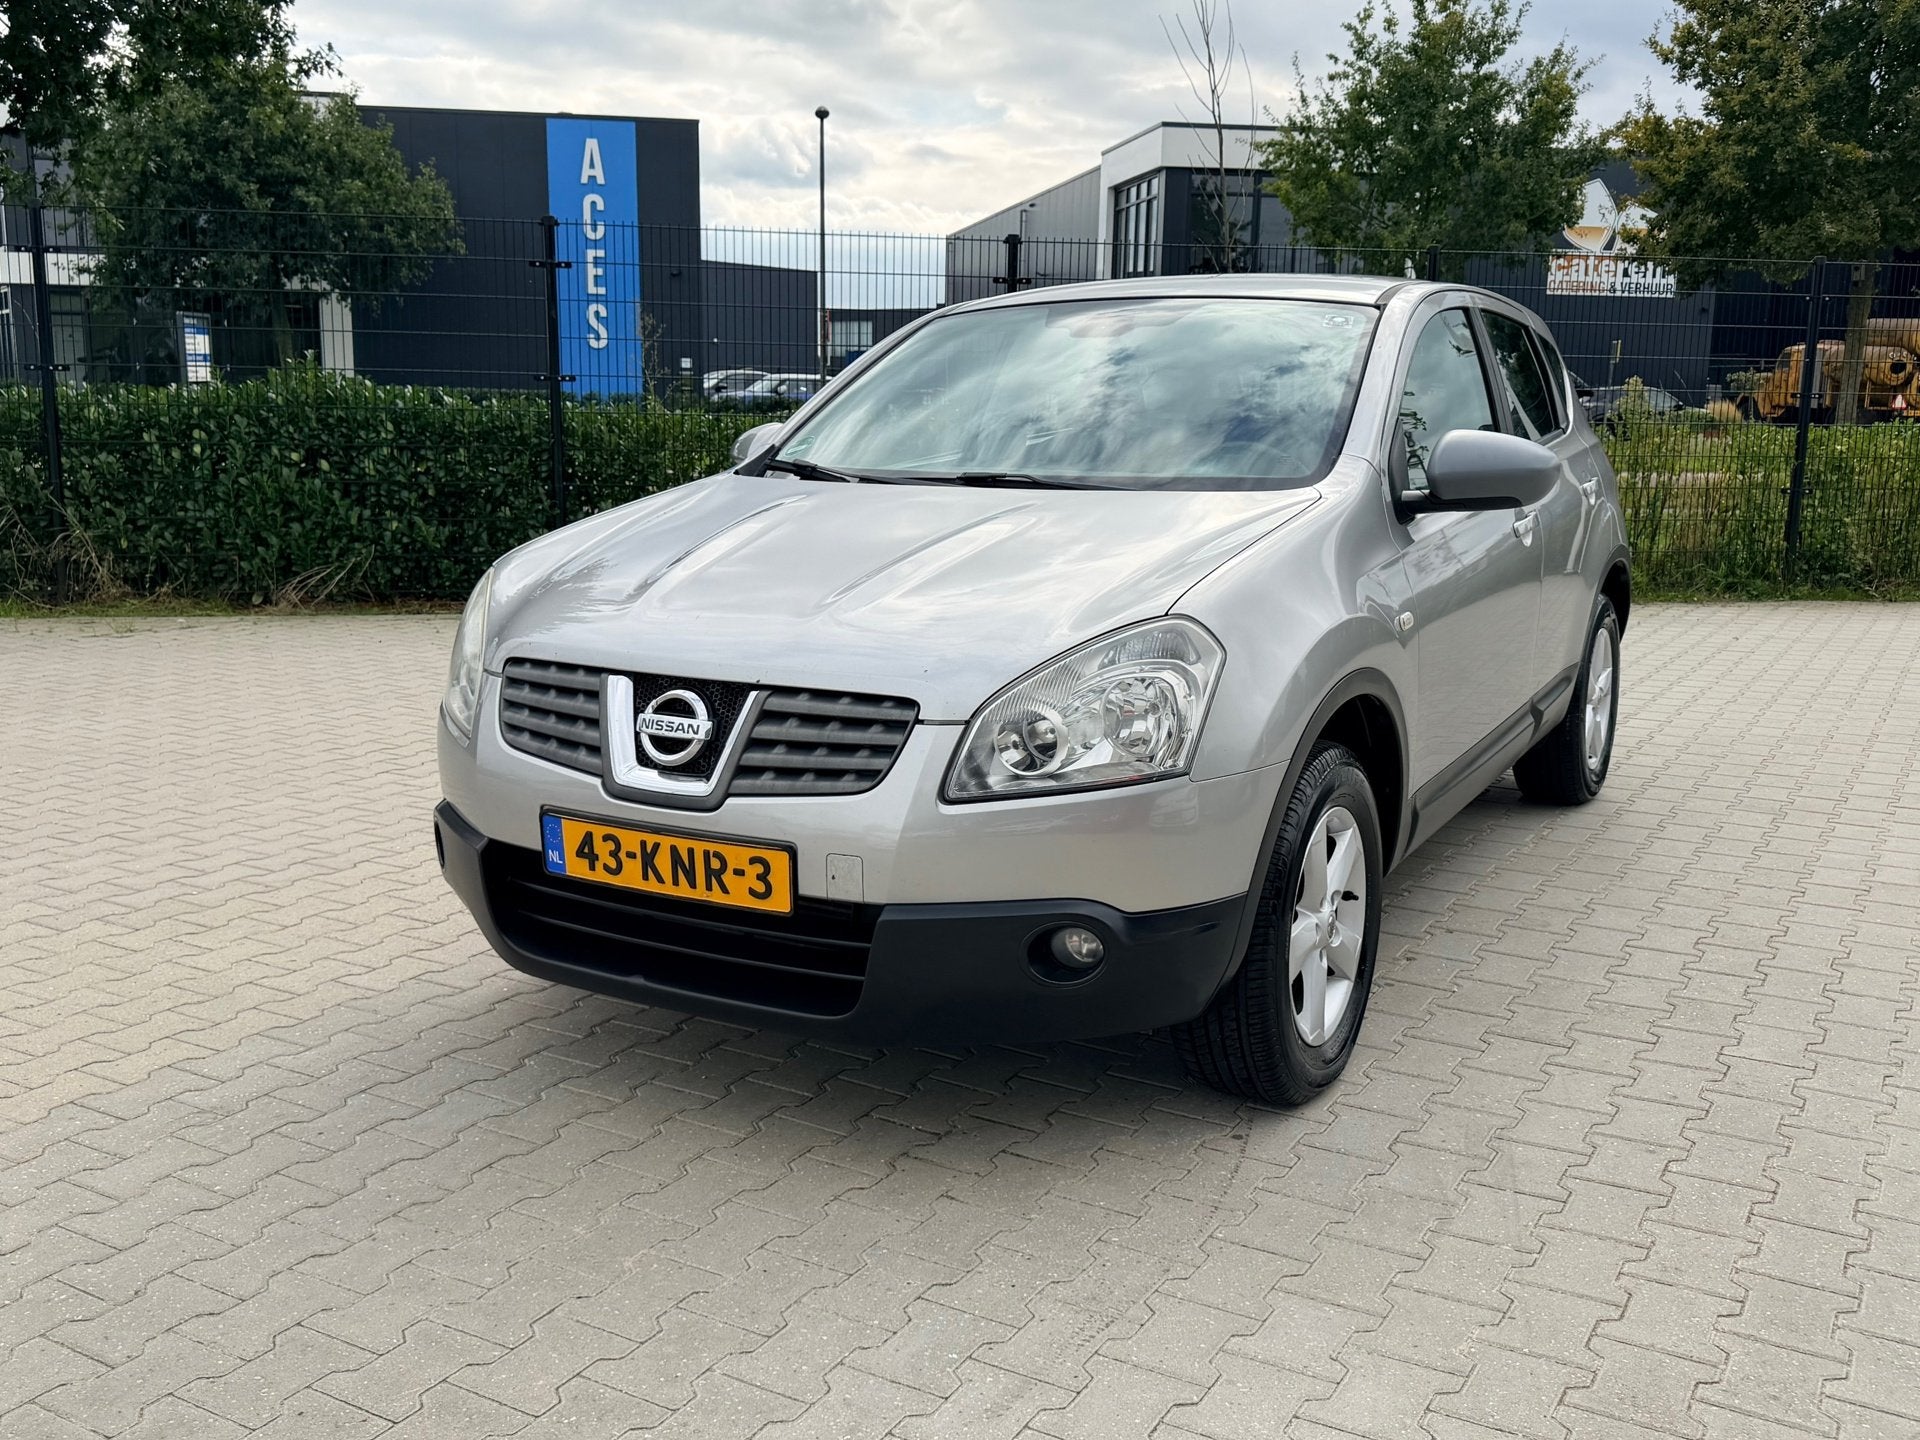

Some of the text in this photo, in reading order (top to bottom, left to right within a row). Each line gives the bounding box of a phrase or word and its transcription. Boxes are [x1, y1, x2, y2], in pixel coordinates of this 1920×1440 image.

[580, 138, 609, 349] ACES
[1548, 279, 1674, 296] CATERING & VERHUUR
[640, 717, 701, 736] NISSAN
[548, 849, 563, 865] NL
[575, 831, 773, 900] 43-KNR-3
